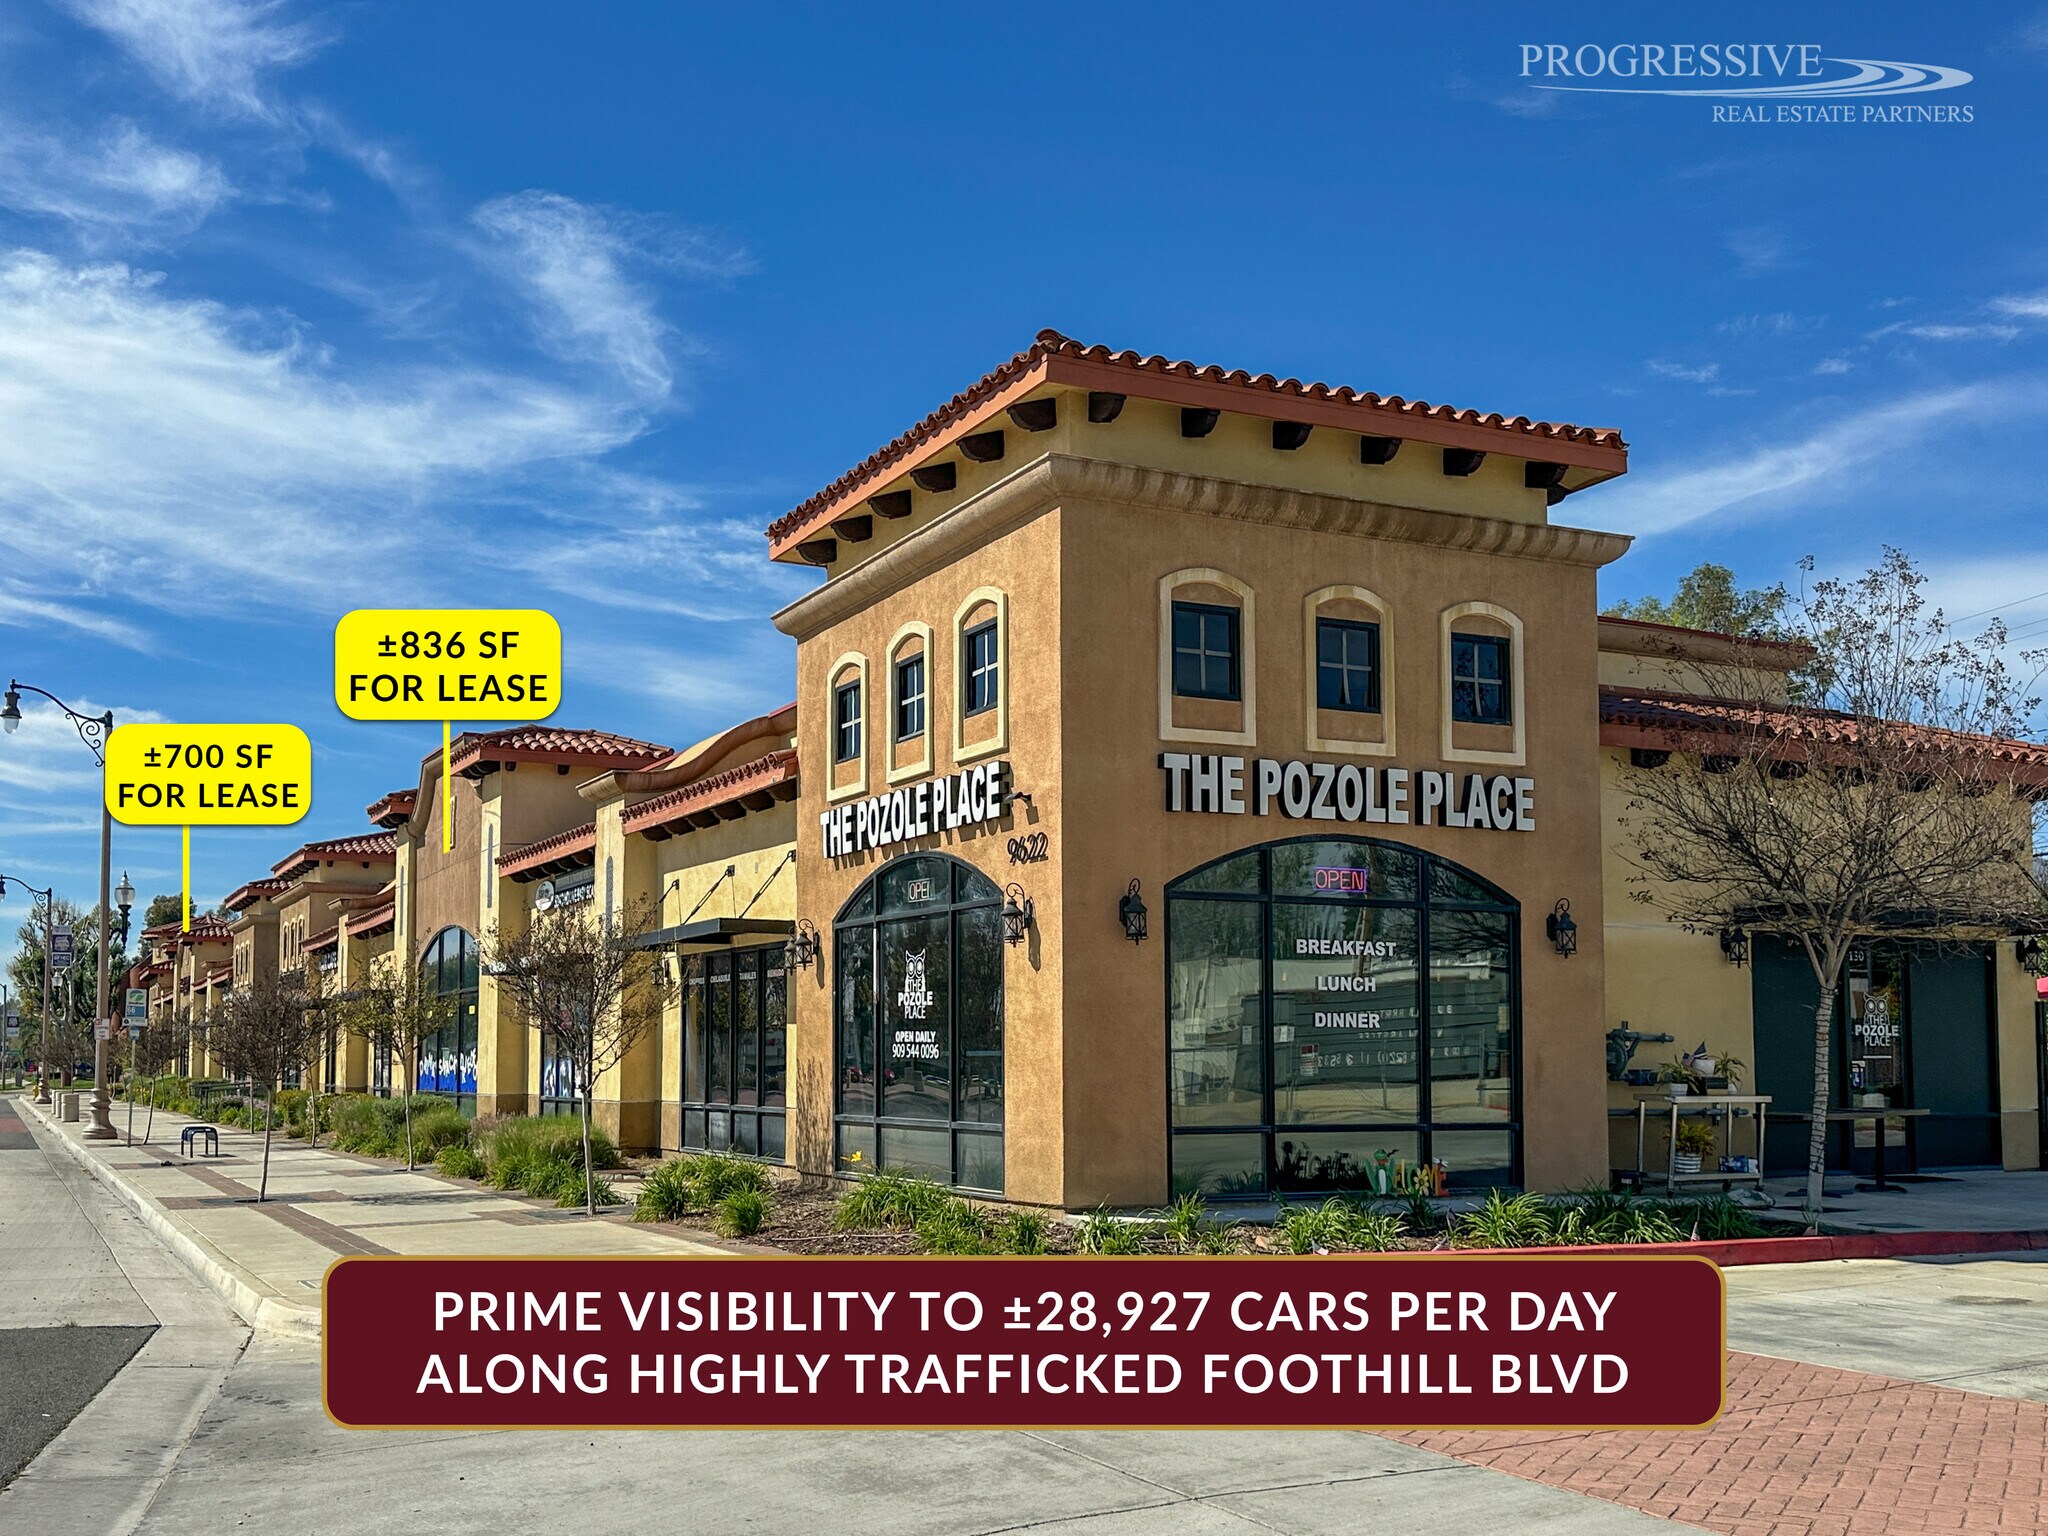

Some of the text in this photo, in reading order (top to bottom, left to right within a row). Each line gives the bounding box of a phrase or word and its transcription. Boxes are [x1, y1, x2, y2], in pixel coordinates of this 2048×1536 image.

[1163, 752, 1536, 831] THE POZOLE PLACE
[819, 760, 1001, 859] THE POZOLE PLACE
[1008, 832, 1047, 864] 9622
[1315, 868, 1364, 890] OPEN
[1296, 939, 1397, 957] BREAKFAST
[908, 979, 921, 991] THE
[1317, 976, 1376, 992] LUNCH
[898, 991, 933, 1006] POZOLE
[904, 1006, 926, 1019] PLACE
[1315, 1012, 1380, 1028] DINNER
[1868, 1015, 1885, 1025] THE
[895, 1031, 936, 1042] OPEN DAILY
[1855, 1025, 1899, 1036] POZOLE
[1864, 1036, 1890, 1046] PLACE
[892, 1044, 939, 1059] 909 544 0096
